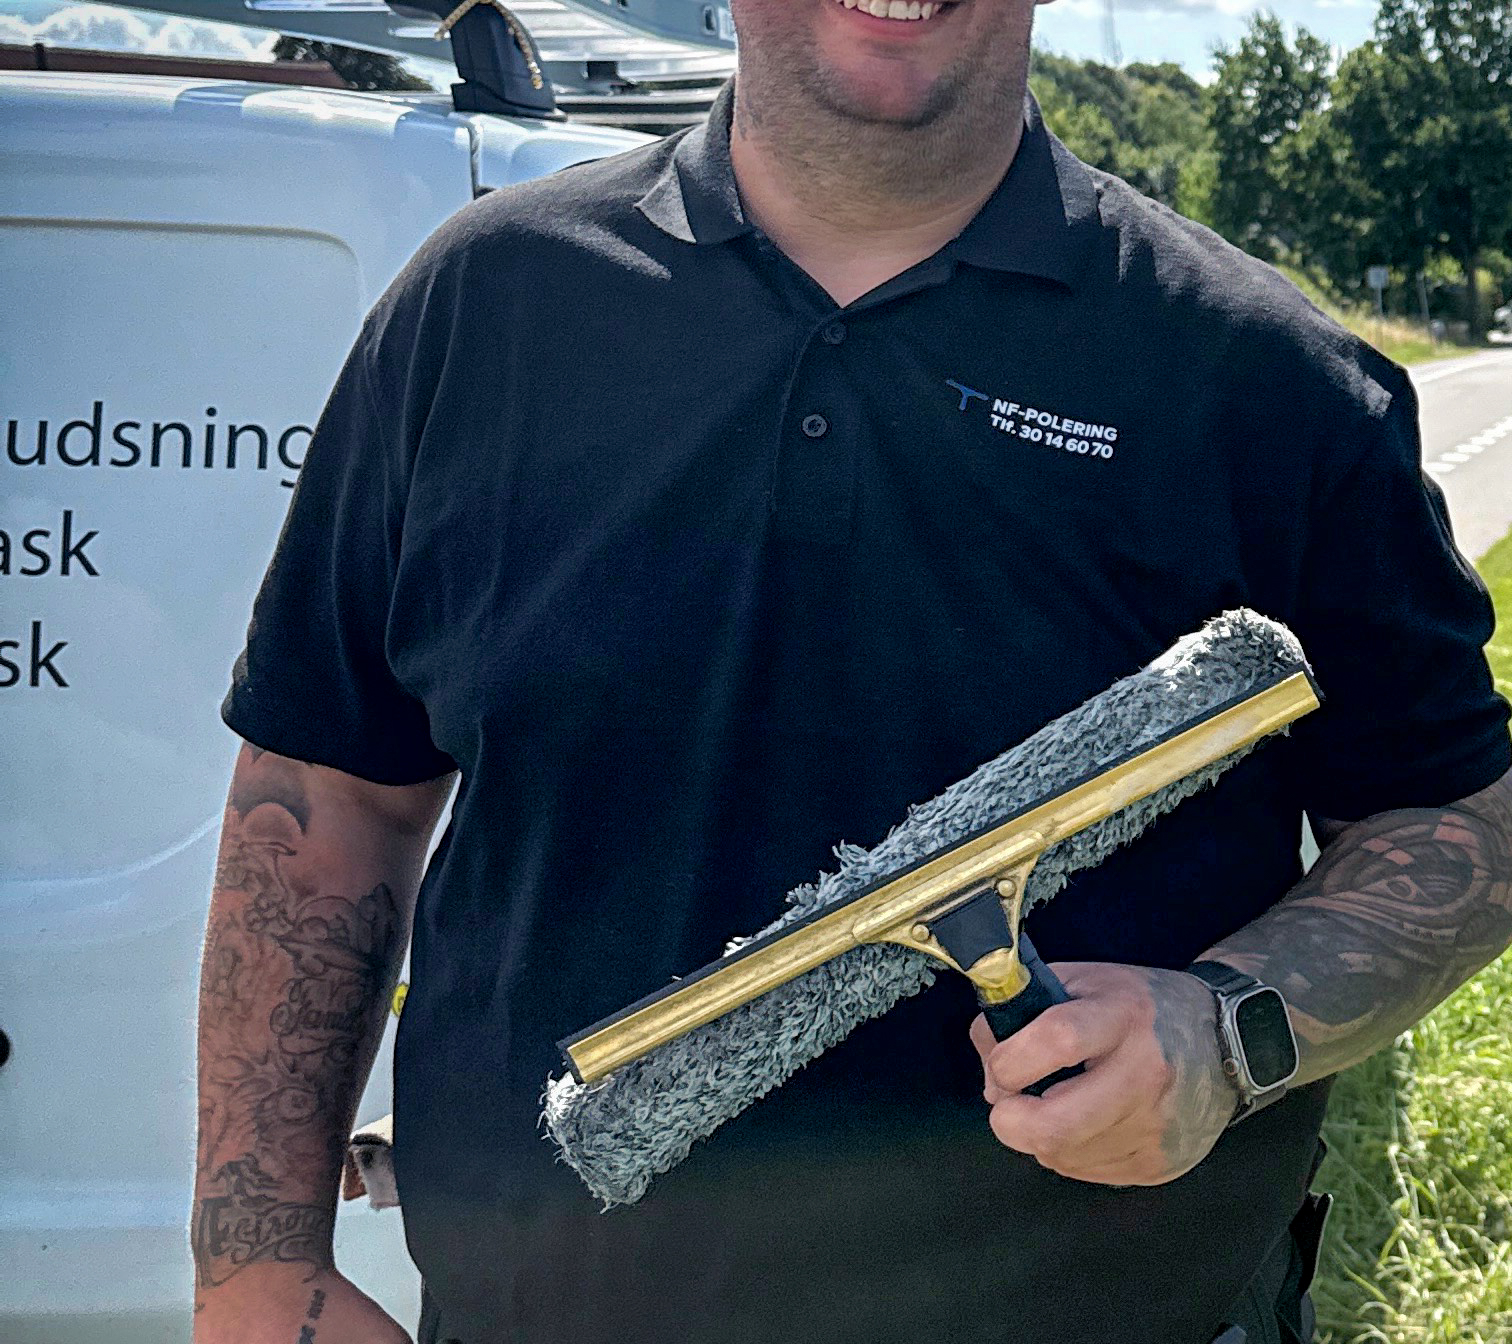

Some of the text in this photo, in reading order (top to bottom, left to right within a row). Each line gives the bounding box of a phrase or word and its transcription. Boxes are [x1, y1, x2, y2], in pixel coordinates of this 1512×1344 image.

[992, 398, 1118, 442] NF-POLERING
[1018, 424, 1043, 442] 30
[1045, 431, 1064, 449] 14
[1065, 437, 1090, 454] 60
[1091, 441, 1114, 459] 70
